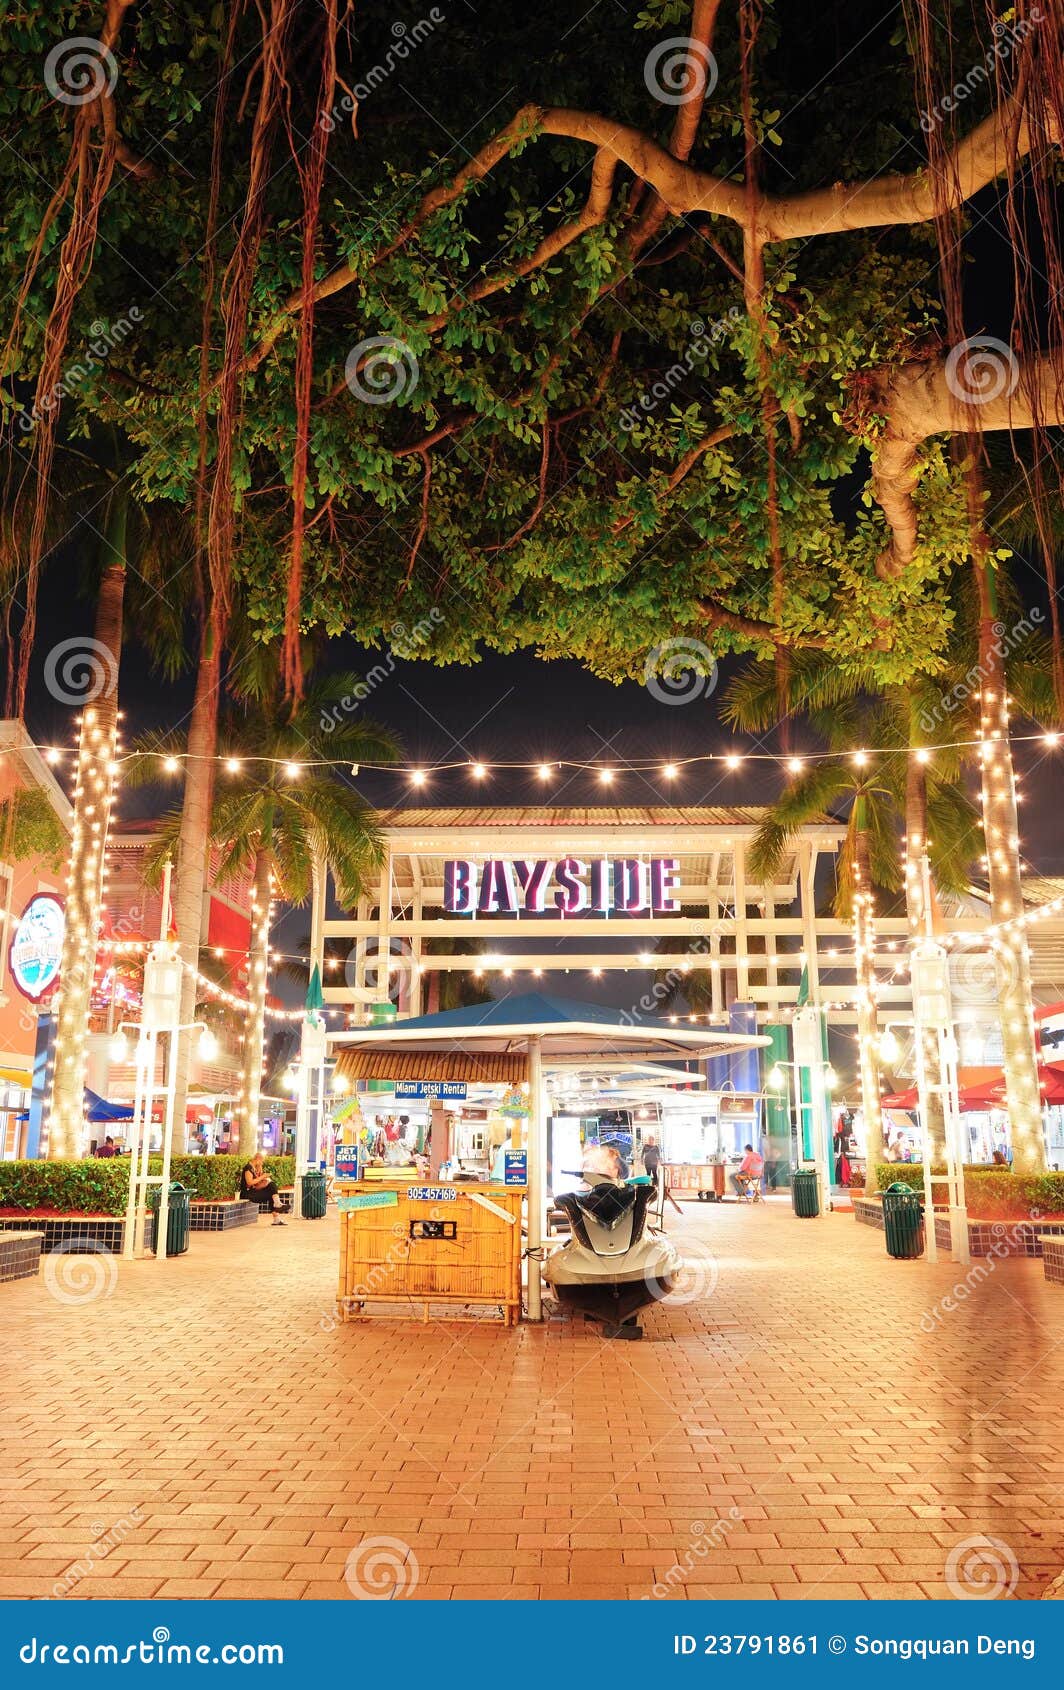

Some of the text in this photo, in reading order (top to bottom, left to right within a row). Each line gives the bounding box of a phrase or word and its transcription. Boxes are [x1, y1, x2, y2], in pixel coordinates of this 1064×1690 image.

[444, 859, 680, 911] BAYSIDE
[396, 1082, 466, 1095] Miami Jetski Rental
[338, 1147, 355, 1155] JET
[408, 1188, 457, 1200] 305-457-1619
